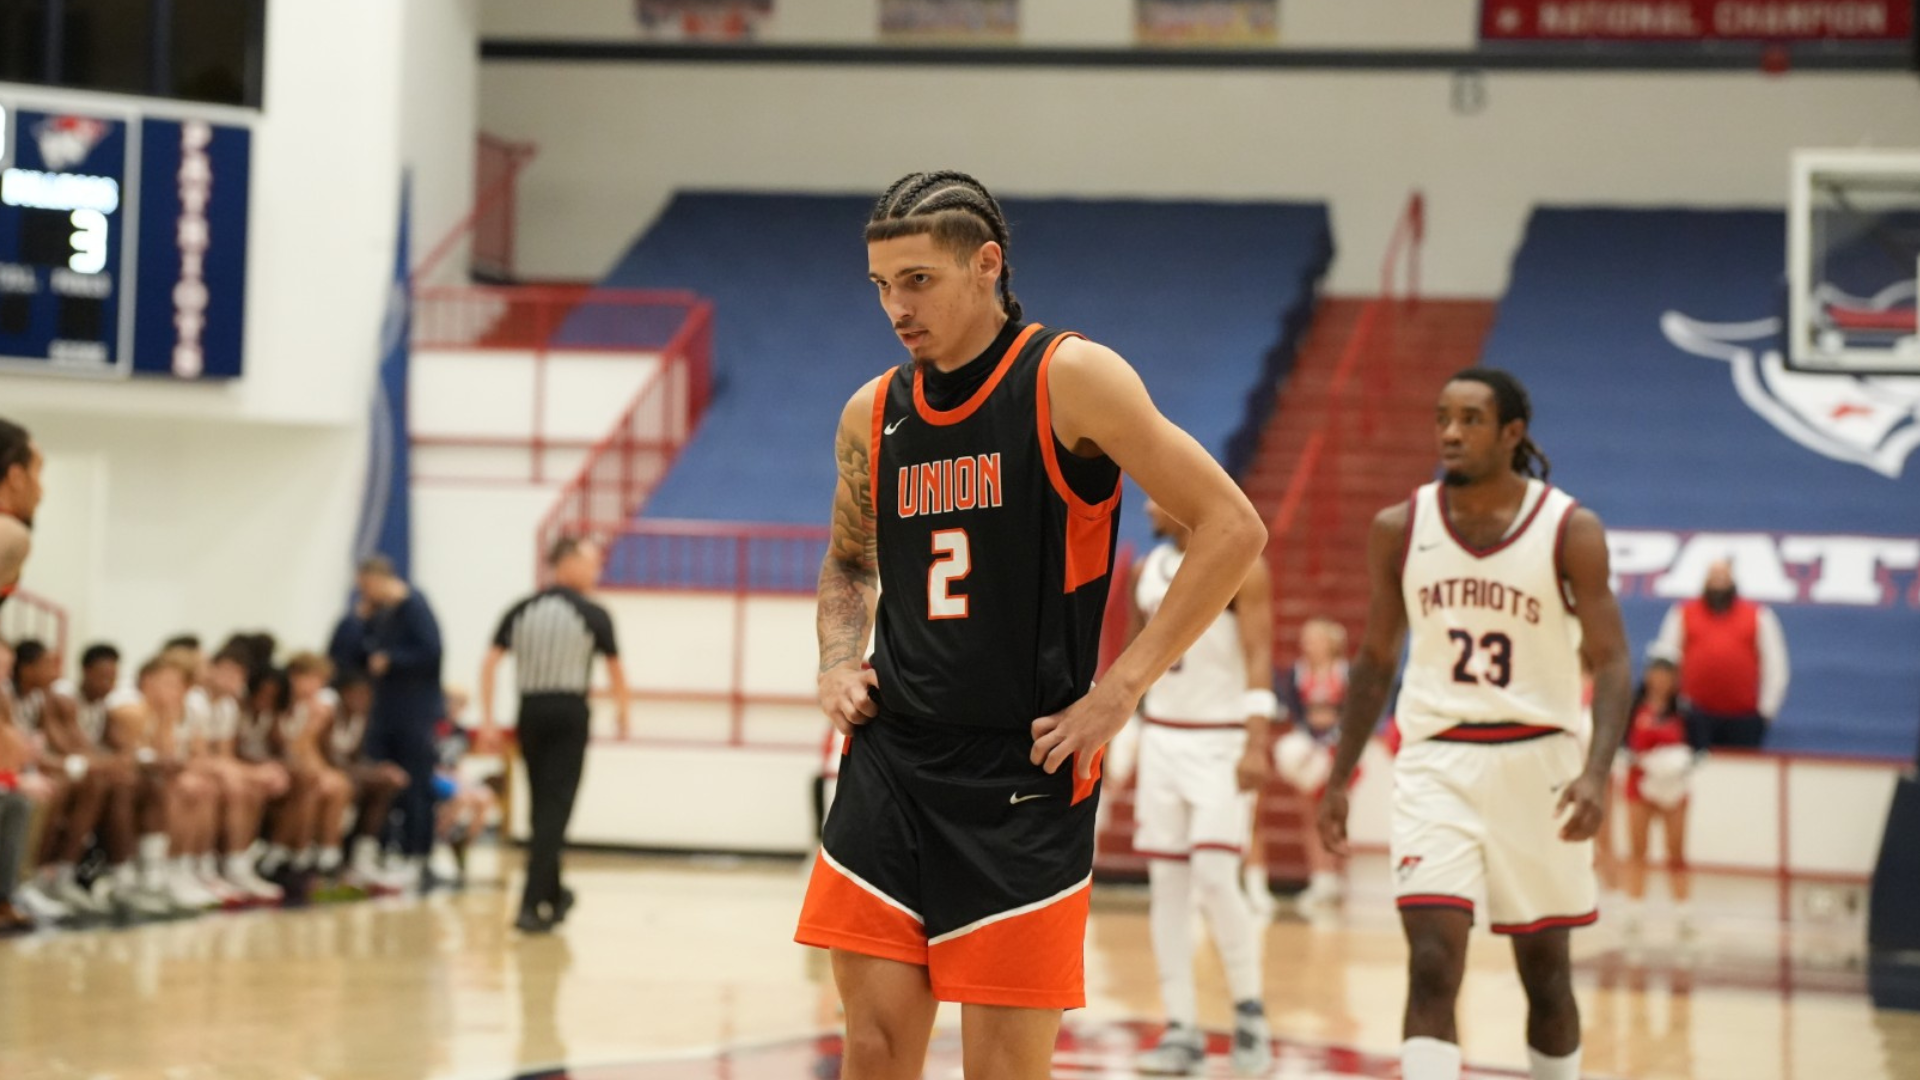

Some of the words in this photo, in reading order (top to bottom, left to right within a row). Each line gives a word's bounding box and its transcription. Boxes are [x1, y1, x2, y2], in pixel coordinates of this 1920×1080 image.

[68, 207, 108, 275] 3
[897, 452, 1003, 519] UNION
[927, 527, 972, 621] 2
[1418, 576, 1541, 627] PATRIOTS
[1447, 627, 1512, 689] 23
